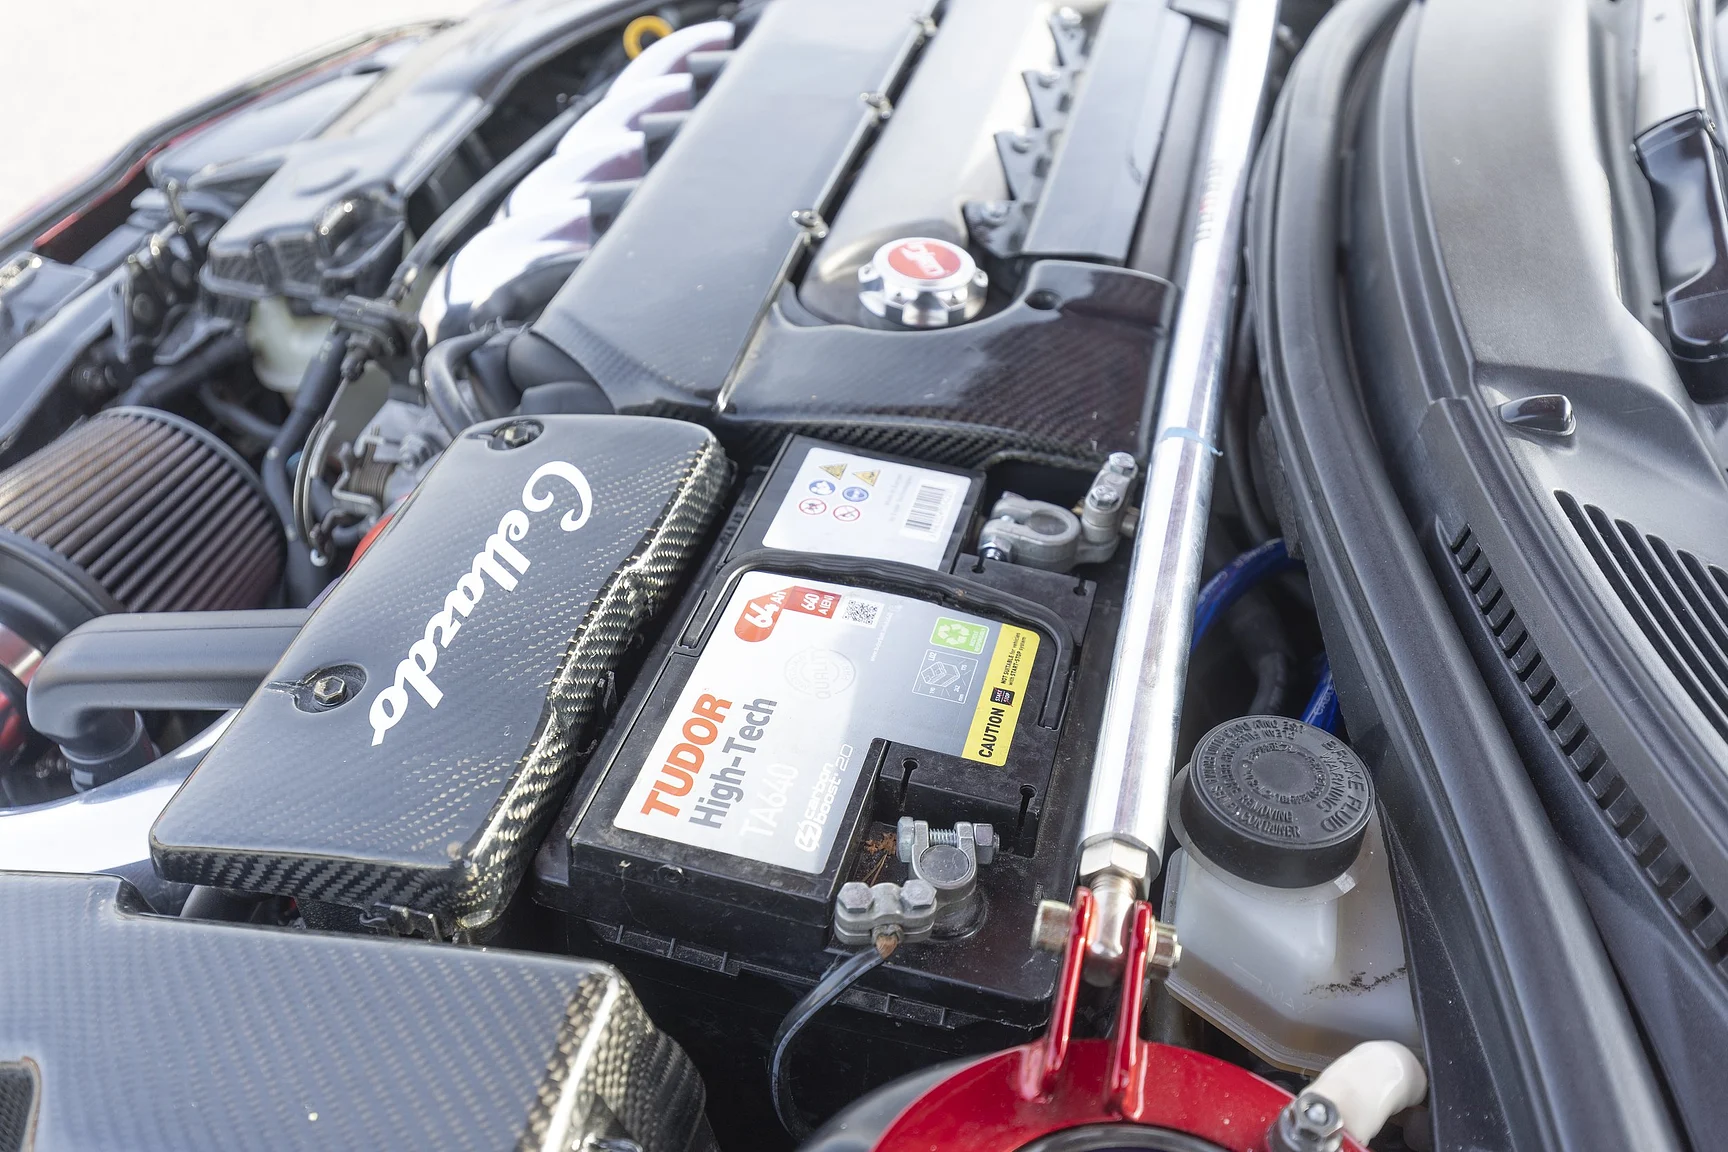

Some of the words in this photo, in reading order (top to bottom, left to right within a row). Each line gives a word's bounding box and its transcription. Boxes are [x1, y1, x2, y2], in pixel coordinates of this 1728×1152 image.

[744, 602, 778, 628] 64
[770, 591, 787, 606] Ah
[801, 592, 820, 611] 640
[1000, 674, 1008, 685] NOT
[1004, 655, 1015, 676] SUITABLE
[1012, 632, 1021, 649] vehicles
[1010, 651, 1022, 677] START-STOP
[640, 693, 732, 817] TUDOR
[978, 707, 1005, 758] CAUTION
[688, 698, 777, 829] High-Tech
[1316, 752, 1345, 813] WARNING
[1321, 739, 1365, 792] BRAKE
[739, 763, 799, 838] TA640
[804, 762, 834, 820] carbon
[1320, 794, 1363, 833] FLUID
